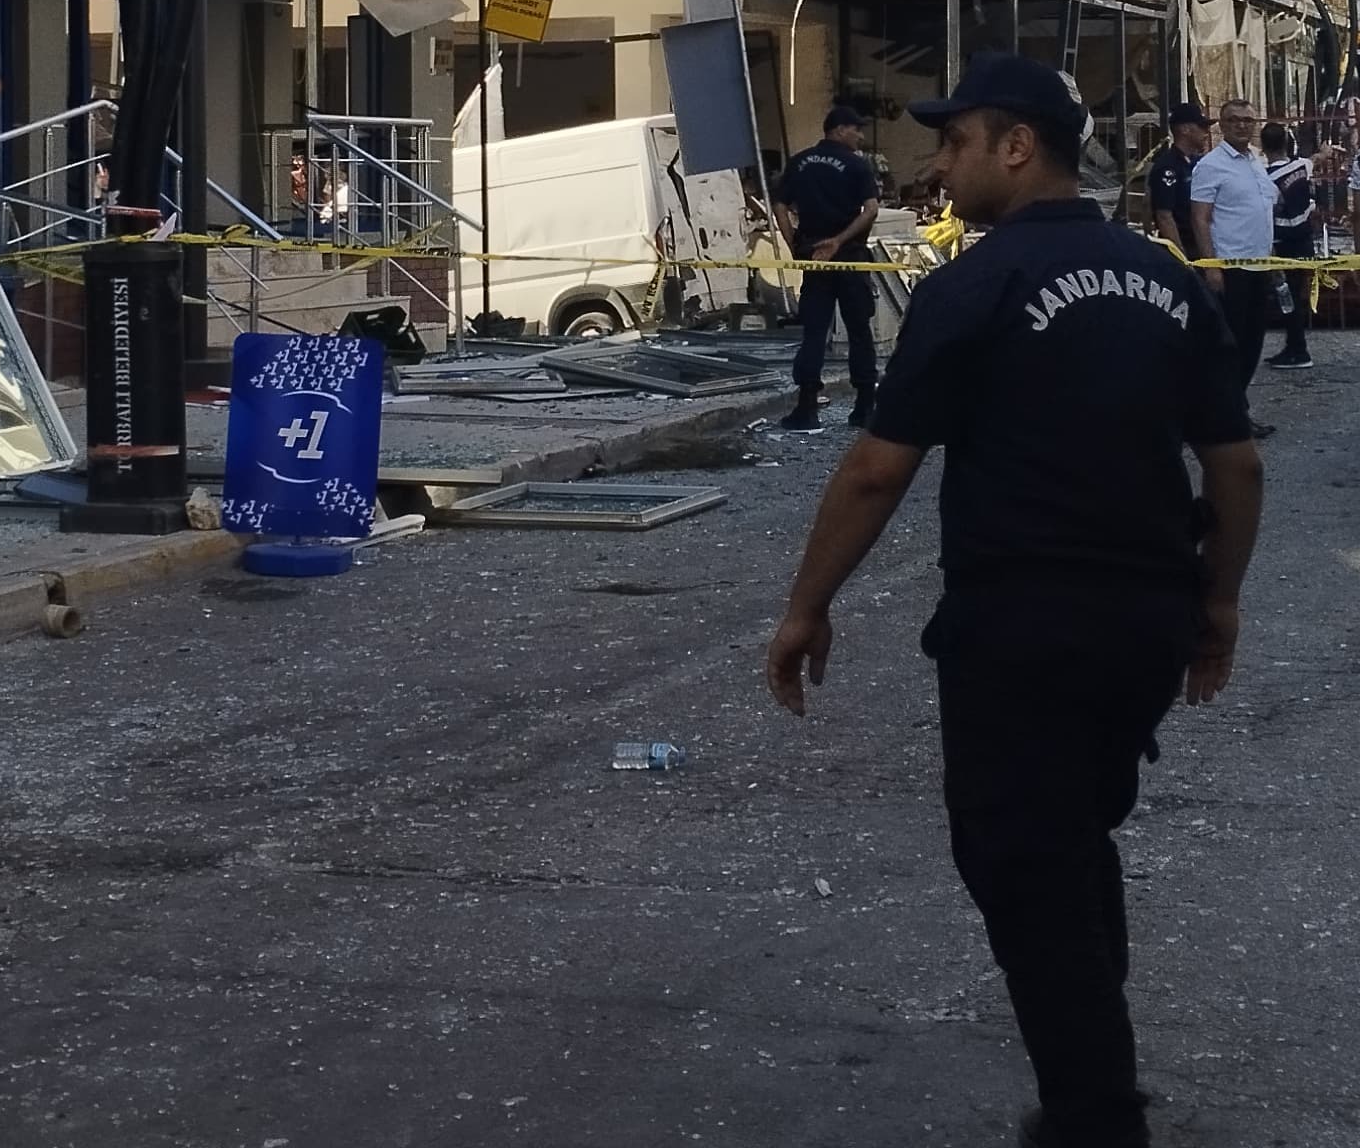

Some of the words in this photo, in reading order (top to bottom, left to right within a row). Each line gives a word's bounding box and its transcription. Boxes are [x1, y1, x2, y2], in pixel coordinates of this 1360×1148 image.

[798, 155, 846, 173] JANDARMA
[1024, 269, 1190, 332] JANDARMA
[278, 411, 329, 459] +1
